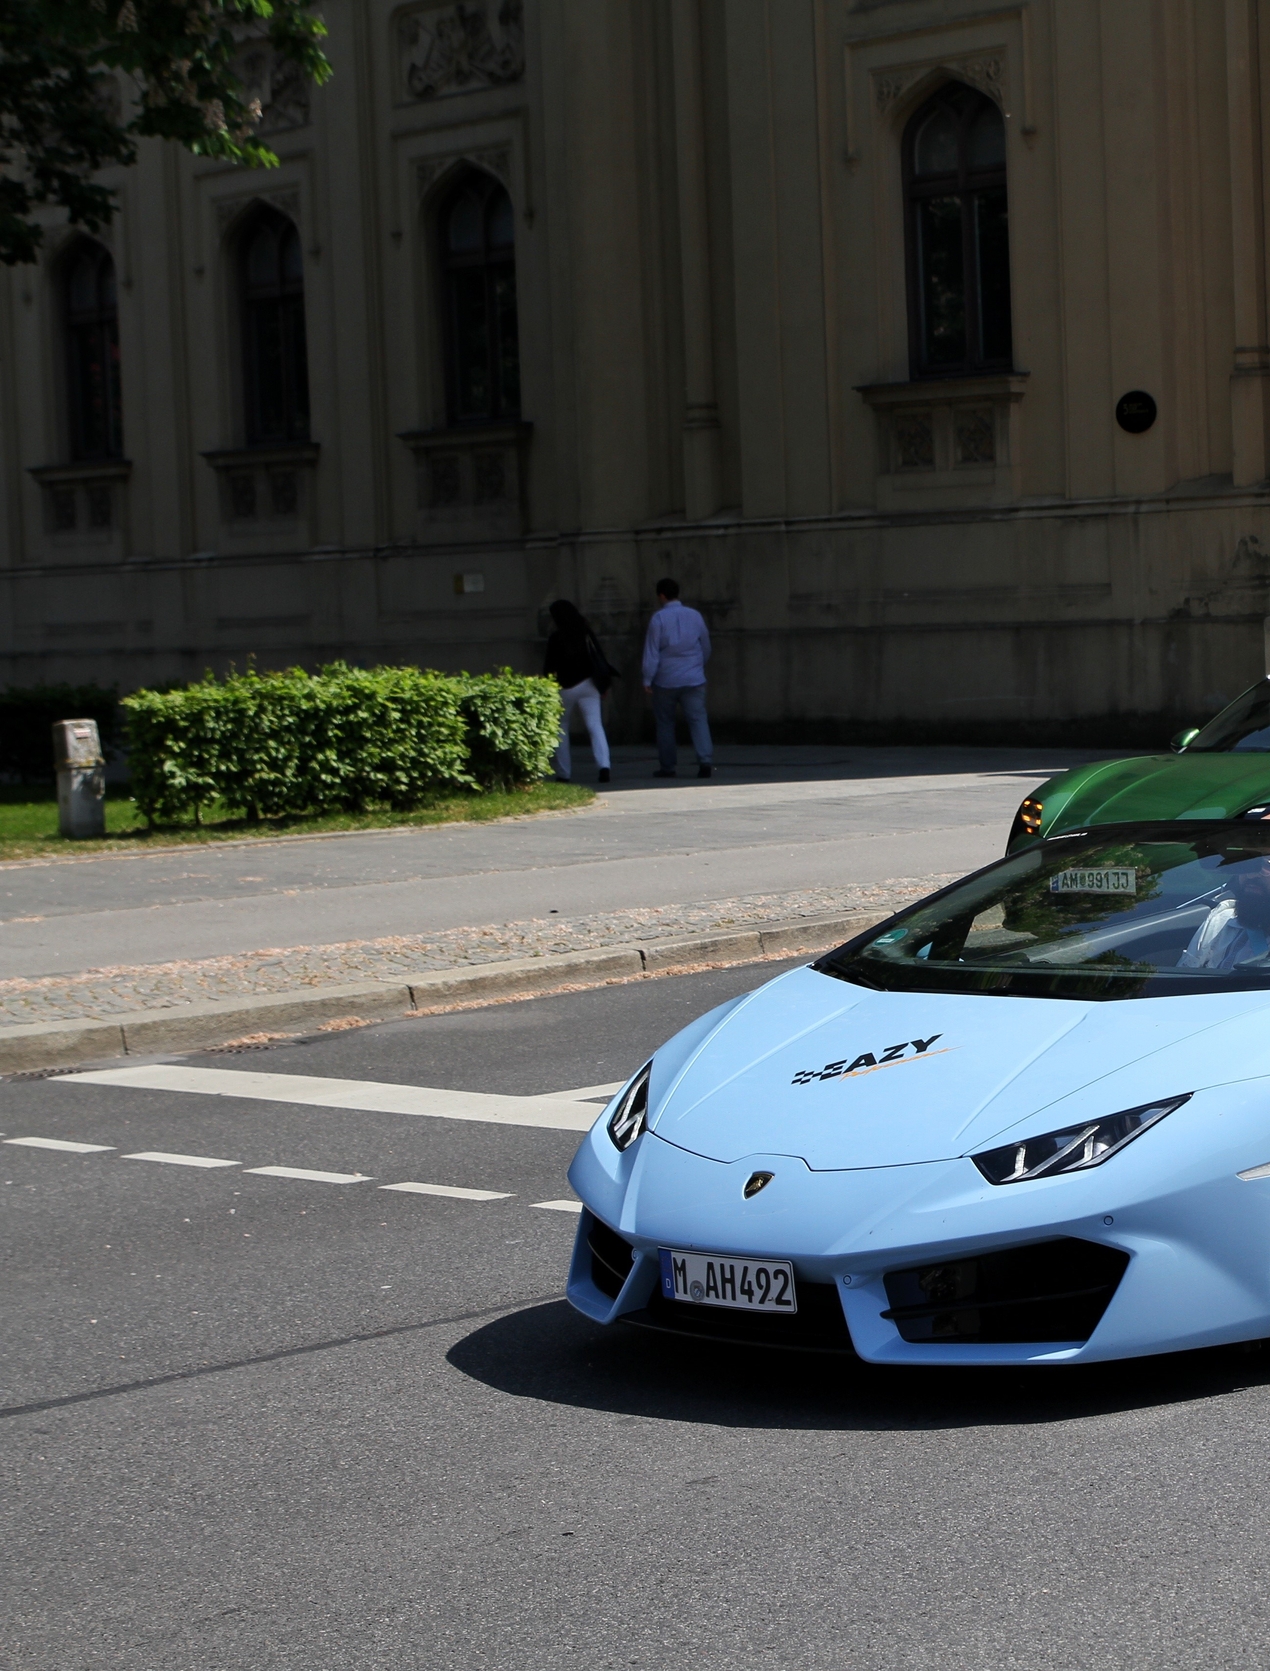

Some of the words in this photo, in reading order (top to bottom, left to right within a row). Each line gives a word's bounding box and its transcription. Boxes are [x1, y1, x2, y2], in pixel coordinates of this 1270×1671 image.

[1061, 872, 1078, 889] AM
[819, 1032, 945, 1082] EAZY
[672, 1256, 688, 1295] M
